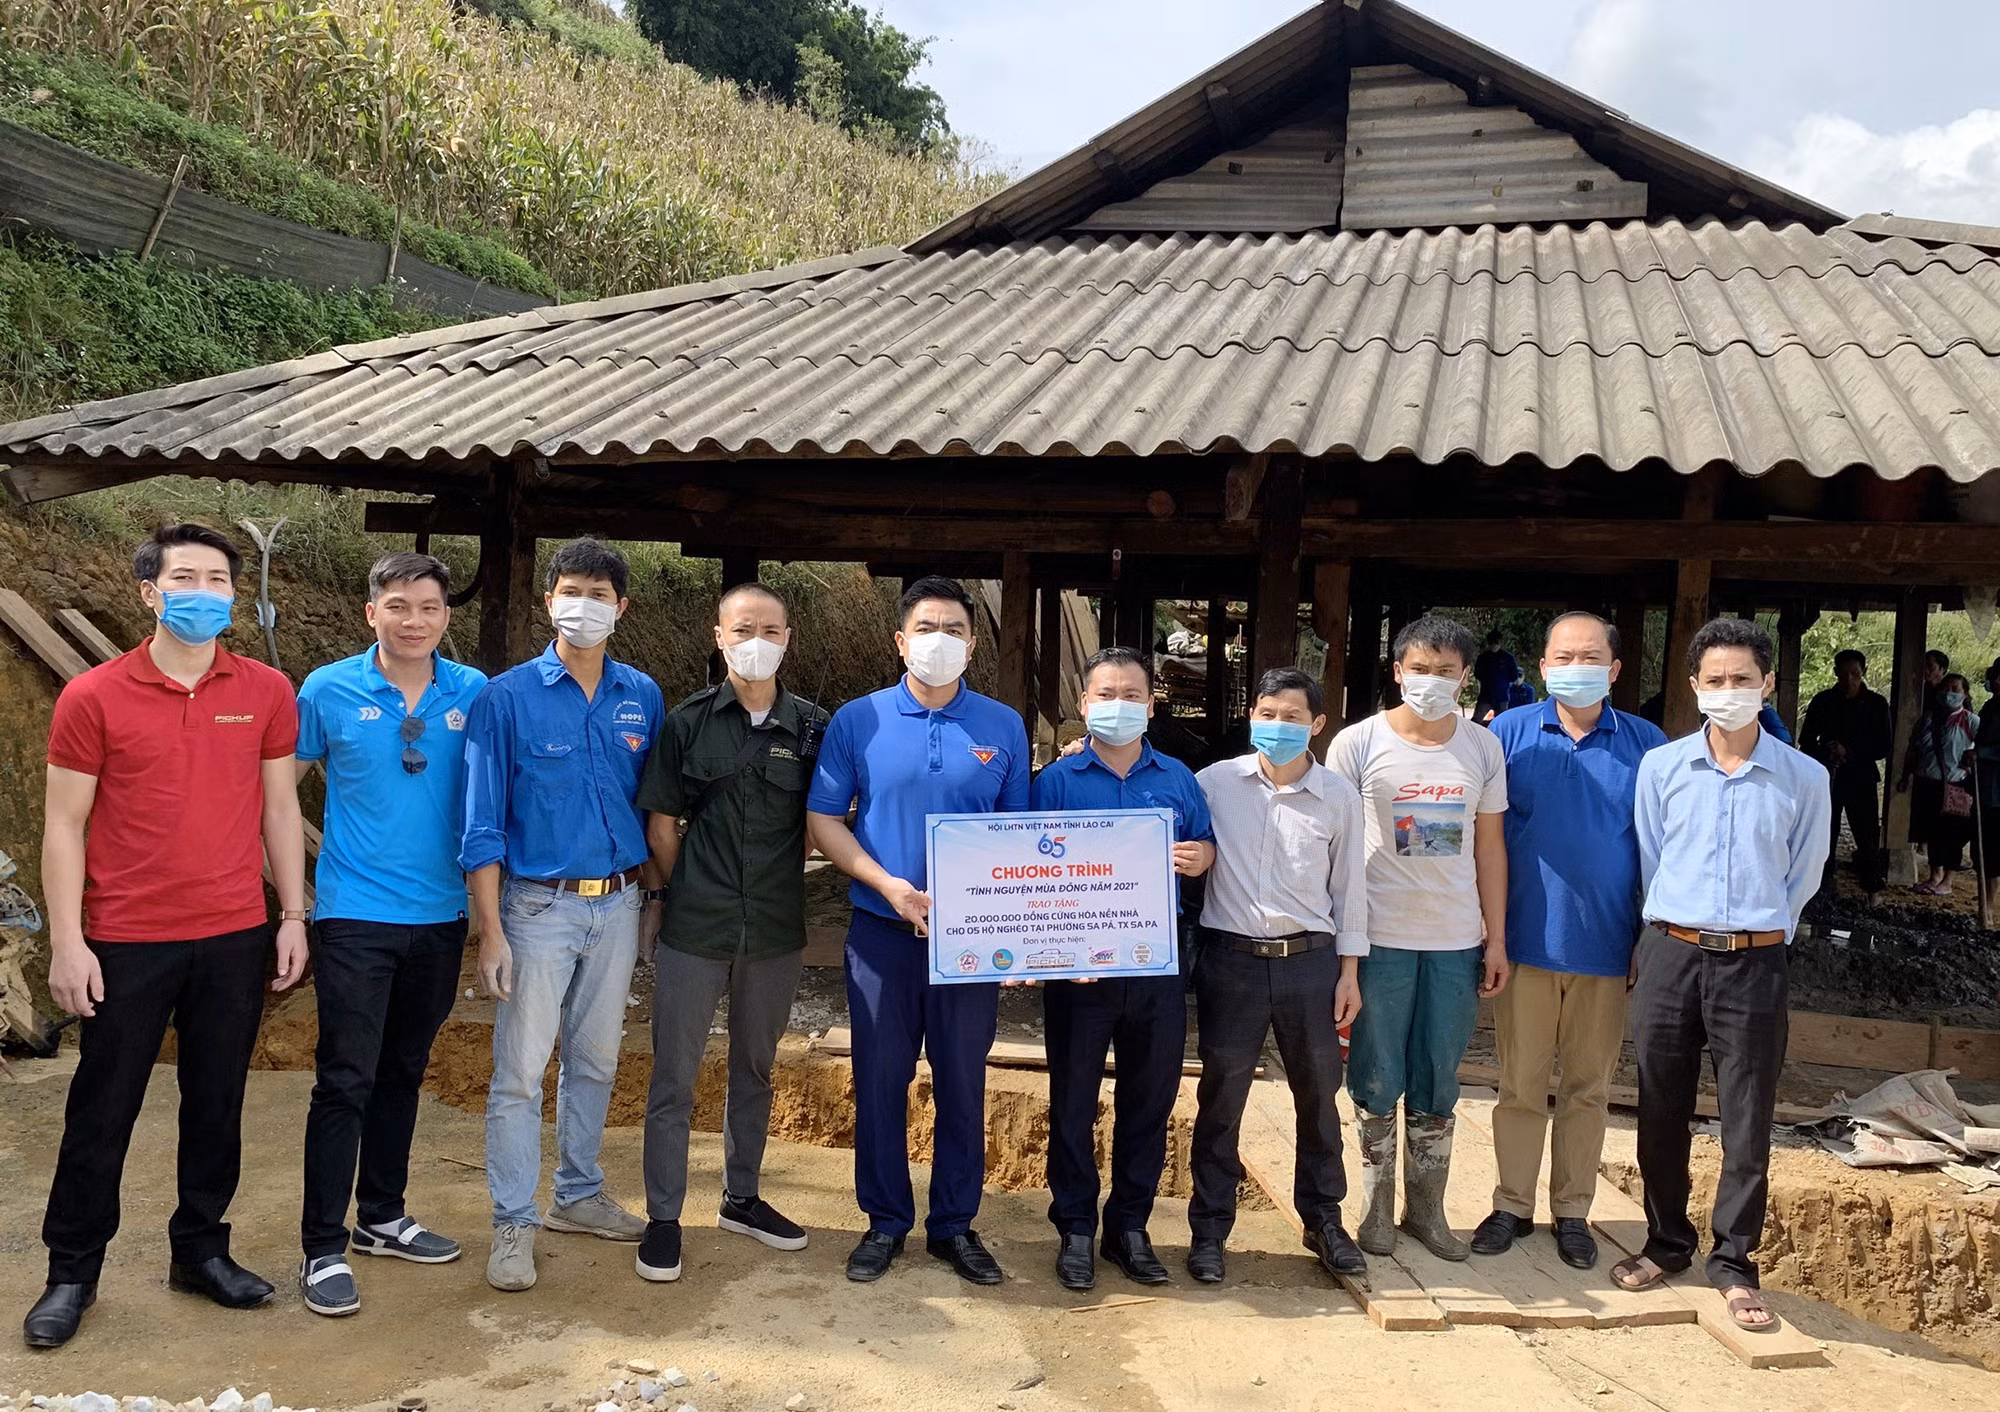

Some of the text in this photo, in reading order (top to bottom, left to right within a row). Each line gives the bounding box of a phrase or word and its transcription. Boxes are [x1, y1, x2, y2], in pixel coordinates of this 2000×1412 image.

[1392, 783, 1464, 801] Sapa
[988, 823, 1002, 832] HỘI
[1025, 821, 1041, 832] VIỆT
[1082, 820, 1098, 828] LÀO
[1038, 833, 1066, 858] 65
[992, 861, 1113, 880] CHƯƠNG TRÌNH
[994, 884, 1033, 896] NGUYỆN
[1035, 883, 1056, 894] MÙA
[1059, 882, 1088, 893] ĐÔNG
[1090, 881, 1112, 892] NĂM
[1027, 898, 1080, 909] TRAO TẶNG
[965, 907, 1139, 923] 20.000.000 ĐỒNG CỨNG HÓA NỀN NHÀ
[946, 927, 965, 935] CHO
[967, 926, 980, 934] 05
[982, 925, 994, 935] HỘ
[997, 924, 1028, 933] NGHÈO
[1030, 924, 1045, 933] TẠI
[1047, 921, 1085, 931] PHƯỜNG
[1087, 922, 1100, 930] SA
[1118, 921, 1129, 929] TX
[1130, 921, 1144, 929] SA
[1145, 920, 1158, 928] PA
[1023, 937, 1039, 945] Đơn
[1040, 937, 1047, 945] vị
[1049, 936, 1066, 945] thực
